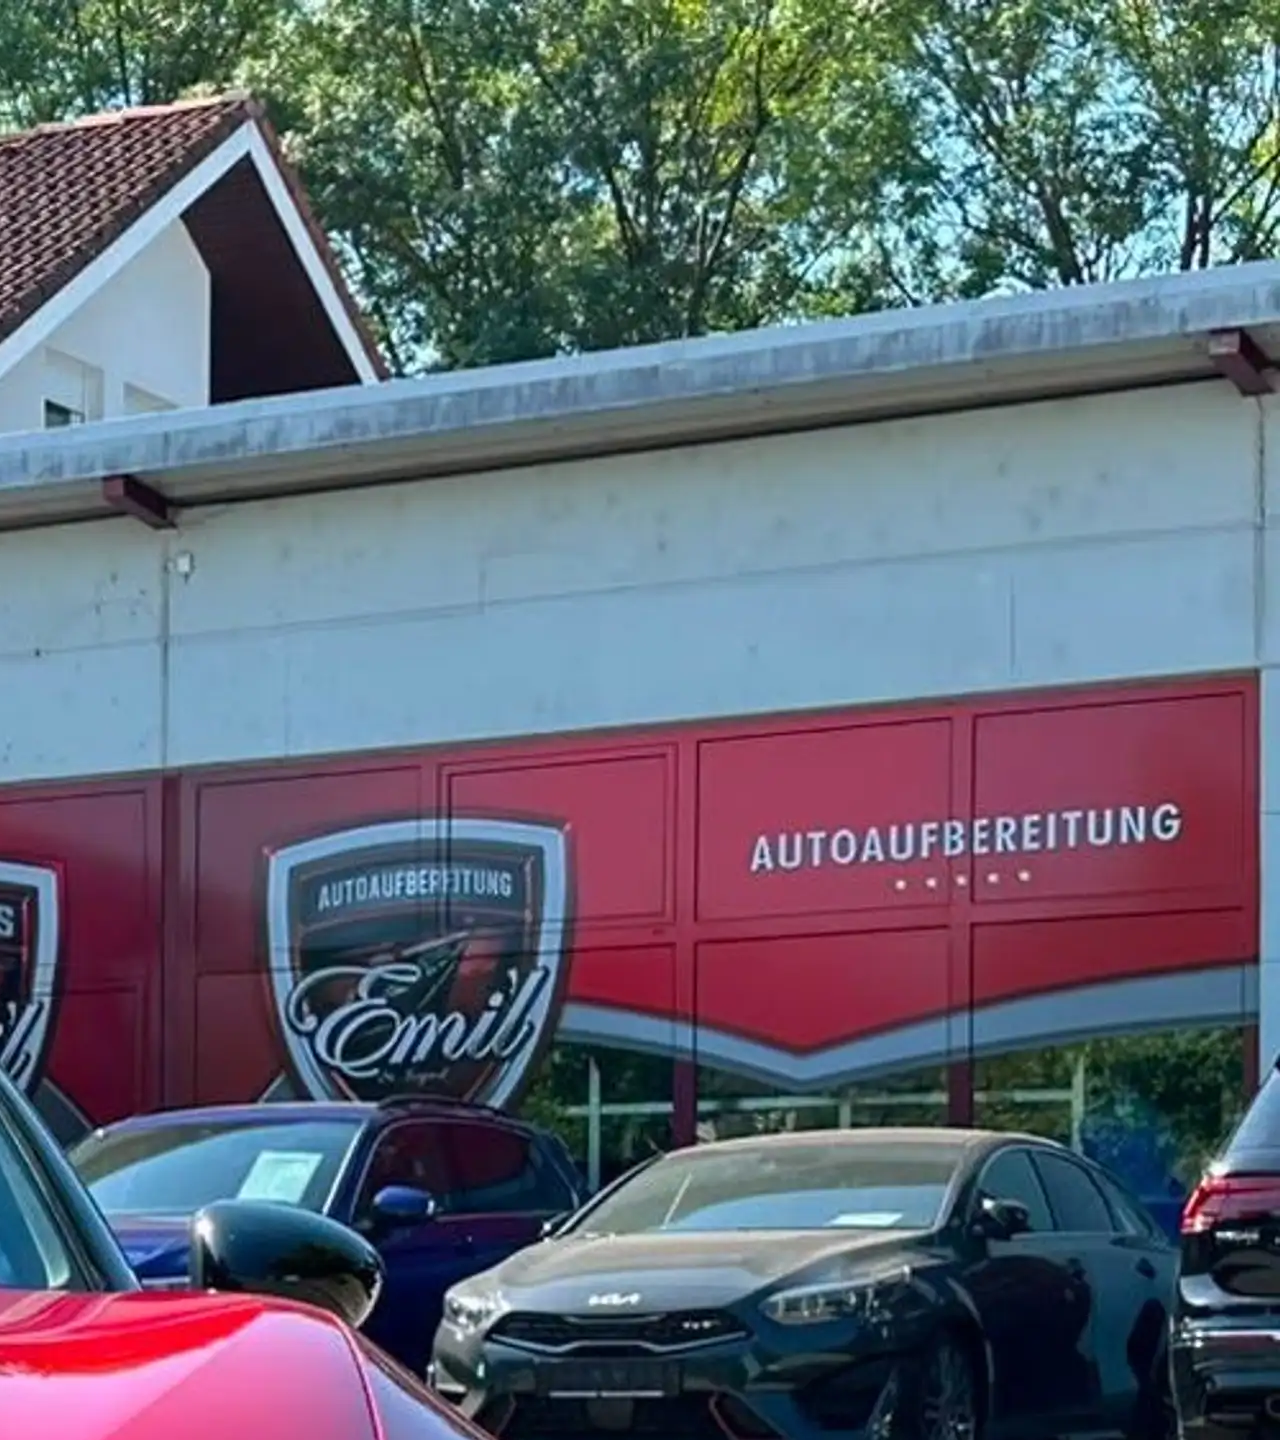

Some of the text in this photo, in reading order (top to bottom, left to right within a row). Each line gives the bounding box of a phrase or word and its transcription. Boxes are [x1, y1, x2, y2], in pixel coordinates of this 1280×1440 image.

[750, 802, 1184, 873] AUTOAUFBEREITUNG
[316, 866, 514, 912] AUTOAUFBEREITUNG
[288, 965, 550, 1079] Emil
